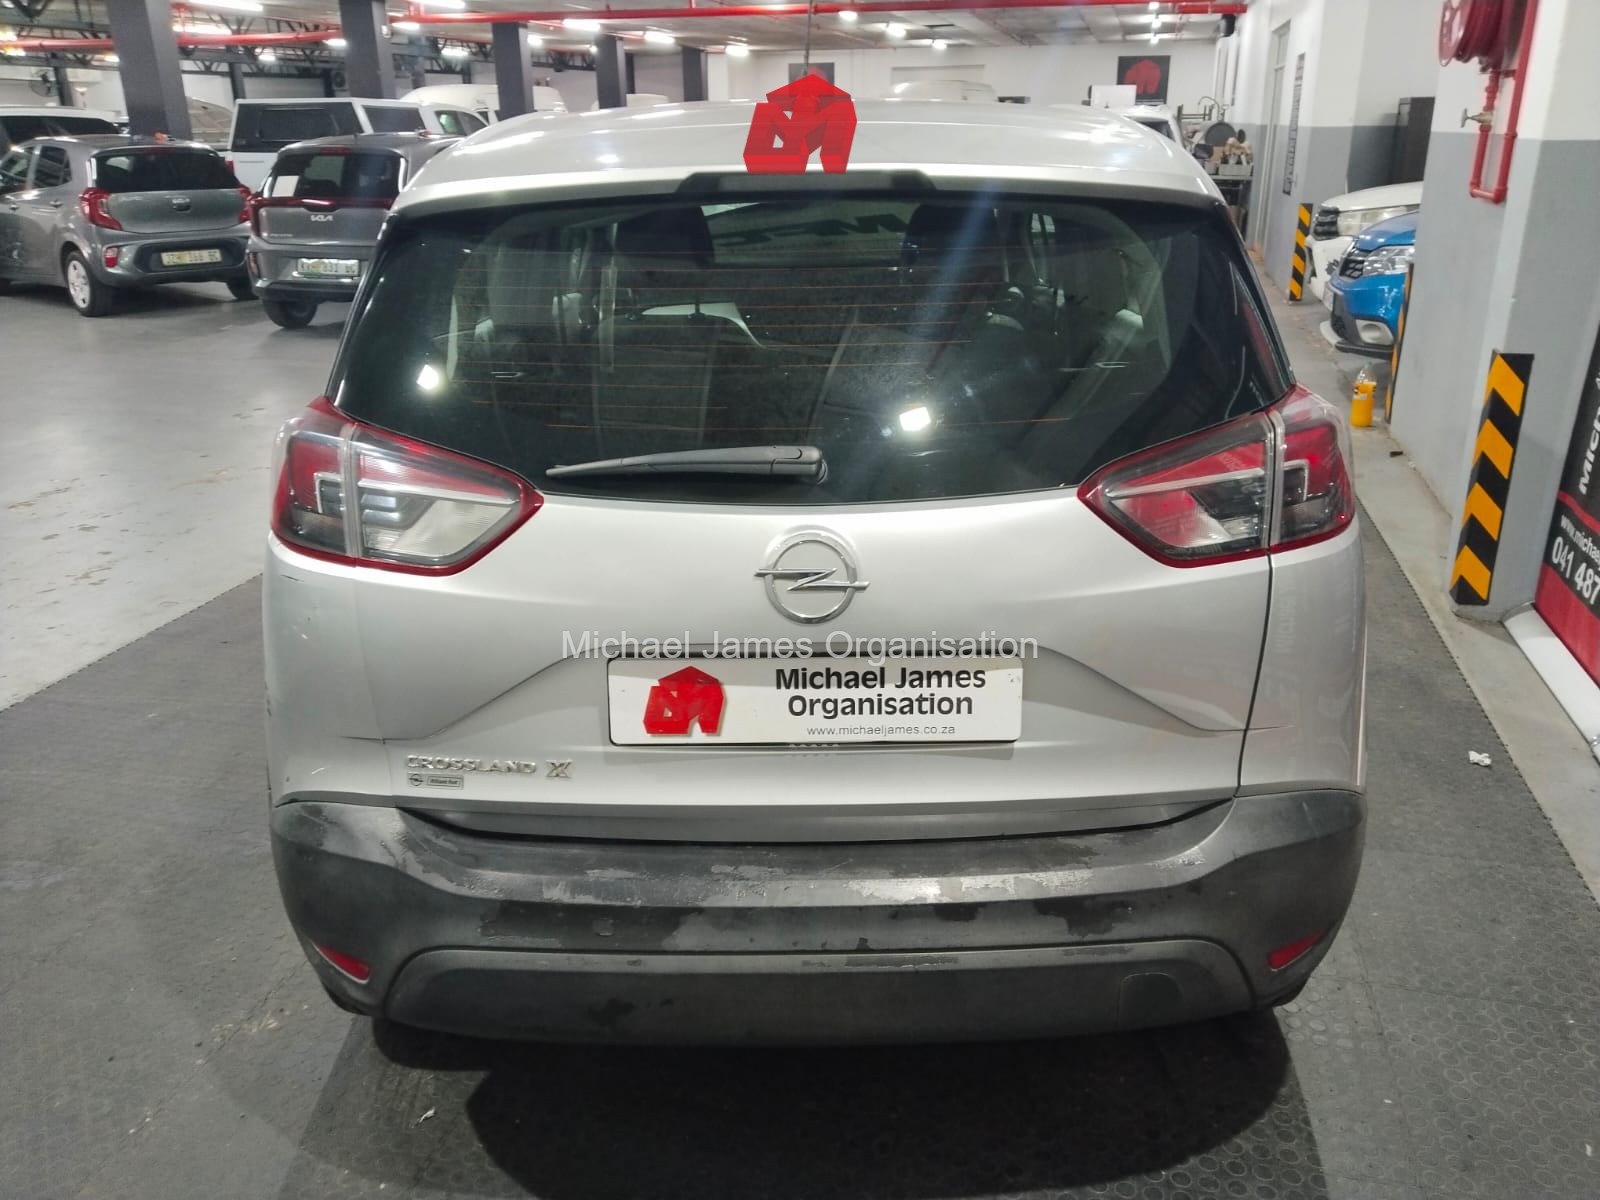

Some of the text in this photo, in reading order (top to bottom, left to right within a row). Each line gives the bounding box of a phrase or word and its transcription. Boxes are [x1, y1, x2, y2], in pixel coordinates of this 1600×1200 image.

[1552, 536, 1575, 579] 041
[775, 666, 987, 690] Michael James
[788, 693, 974, 720] Organisation
[806, 724, 956, 737] www.michaeljames.co.za
[407, 755, 574, 778] CROSSLAND X
